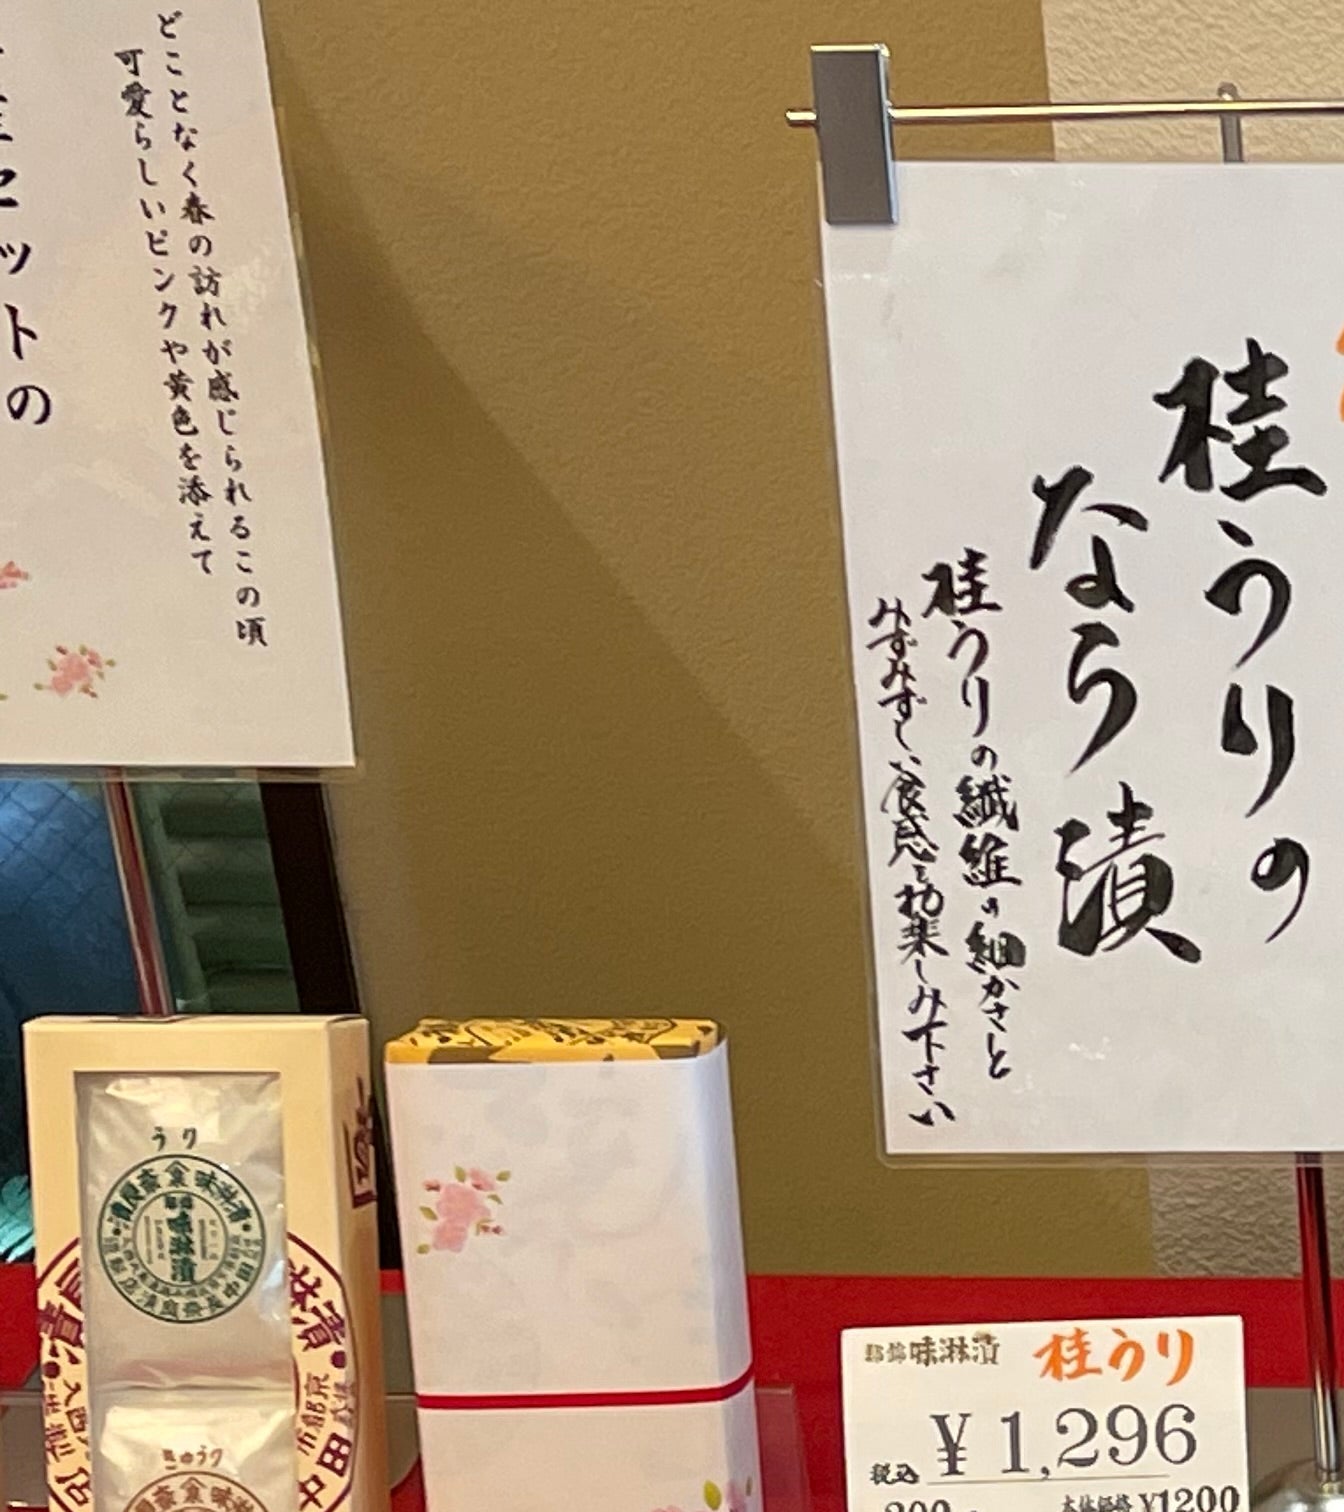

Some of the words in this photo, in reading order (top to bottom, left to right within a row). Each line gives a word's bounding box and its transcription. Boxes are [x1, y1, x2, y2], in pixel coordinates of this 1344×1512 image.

[114, 49, 214, 574] 可愛らしいピンクや黄色を添えて
[156, 11, 268, 648] どことなく春の訪れが感じられるこの頃
[921, 547, 1027, 1079] 桂うりの繊維の細かさと
[1030, 466, 1201, 963] なら漬
[1153, 338, 1327, 942] 桂うりの
[151, 1126, 198, 1151] うり
[1034, 1327, 1195, 1387] 桂うり
[869, 1463, 920, 1485] 税込
[929, 1403, 1198, 1481] ¥1,296
